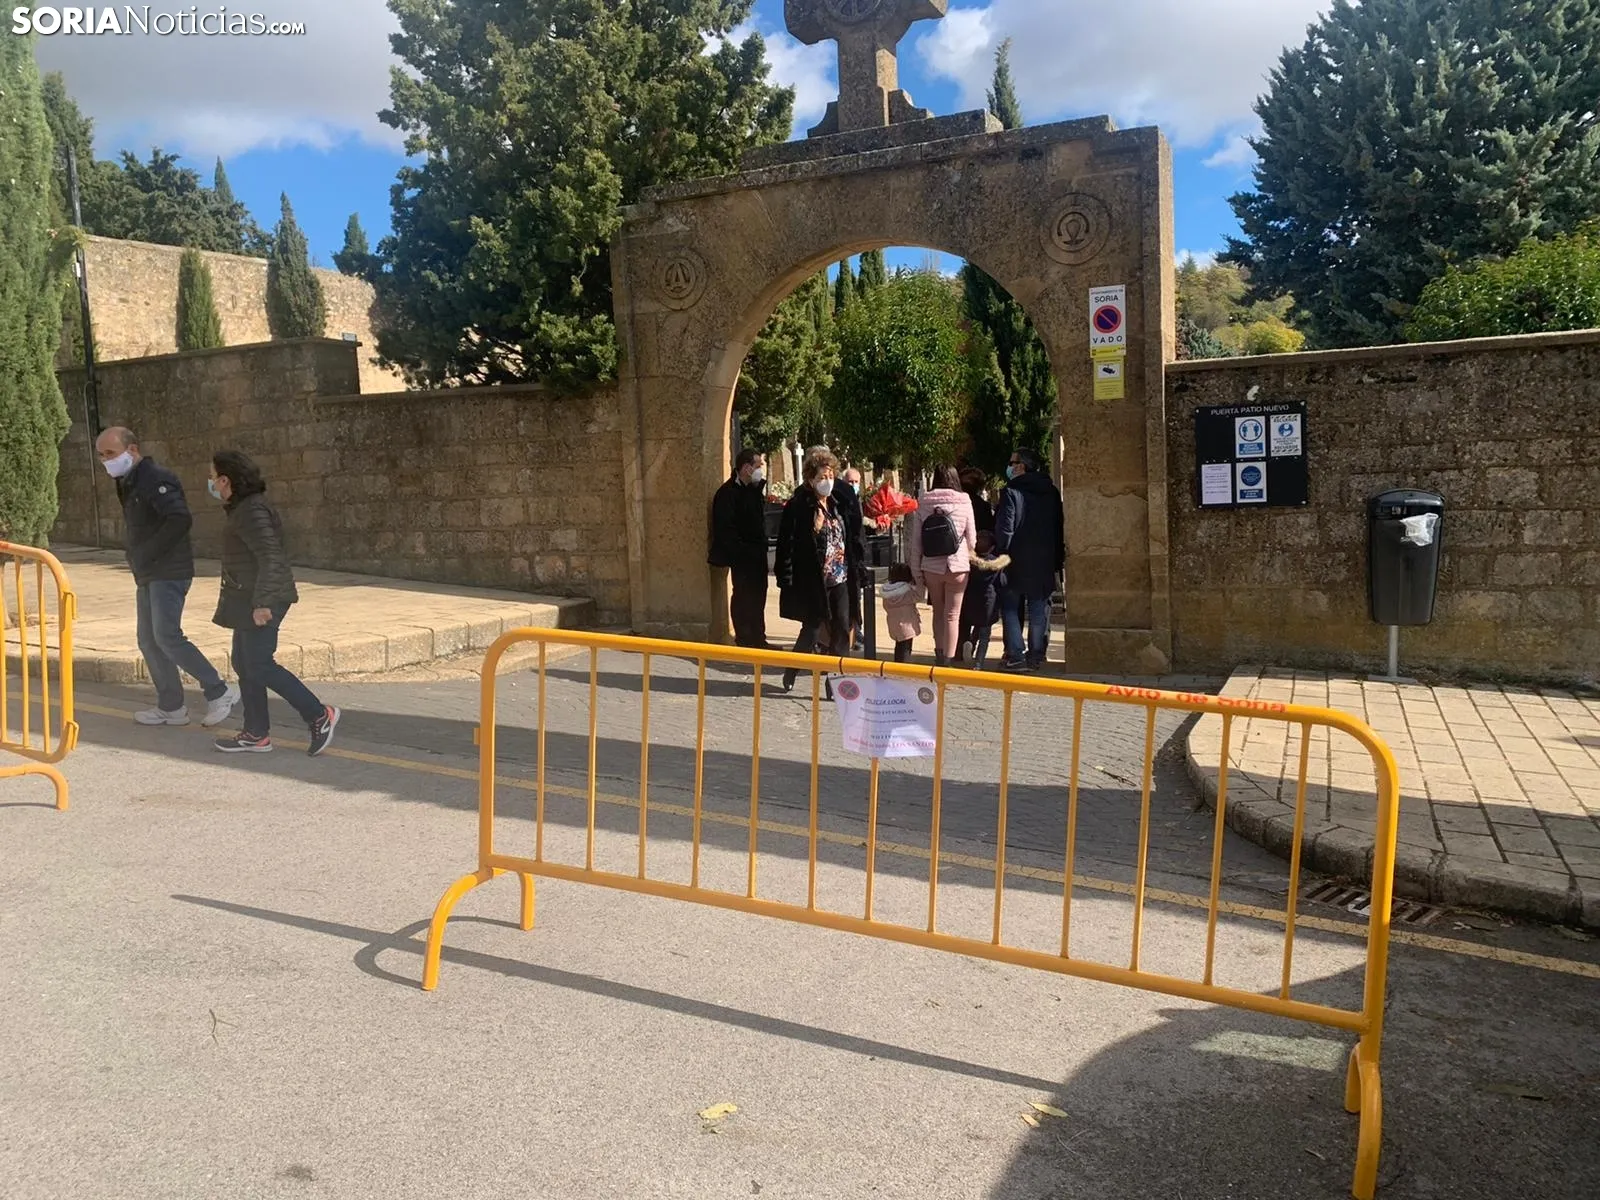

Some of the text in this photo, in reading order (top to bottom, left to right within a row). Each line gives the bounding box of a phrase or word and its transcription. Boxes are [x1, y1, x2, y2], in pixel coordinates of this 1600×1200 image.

[1094, 294, 1119, 303] SORIA
[1092, 335, 1123, 344] VADO
[1210, 404, 1290, 416] PUERTA PATIO NUEVO
[1176, 693, 1208, 704] de
[1217, 696, 1286, 712] Soria
